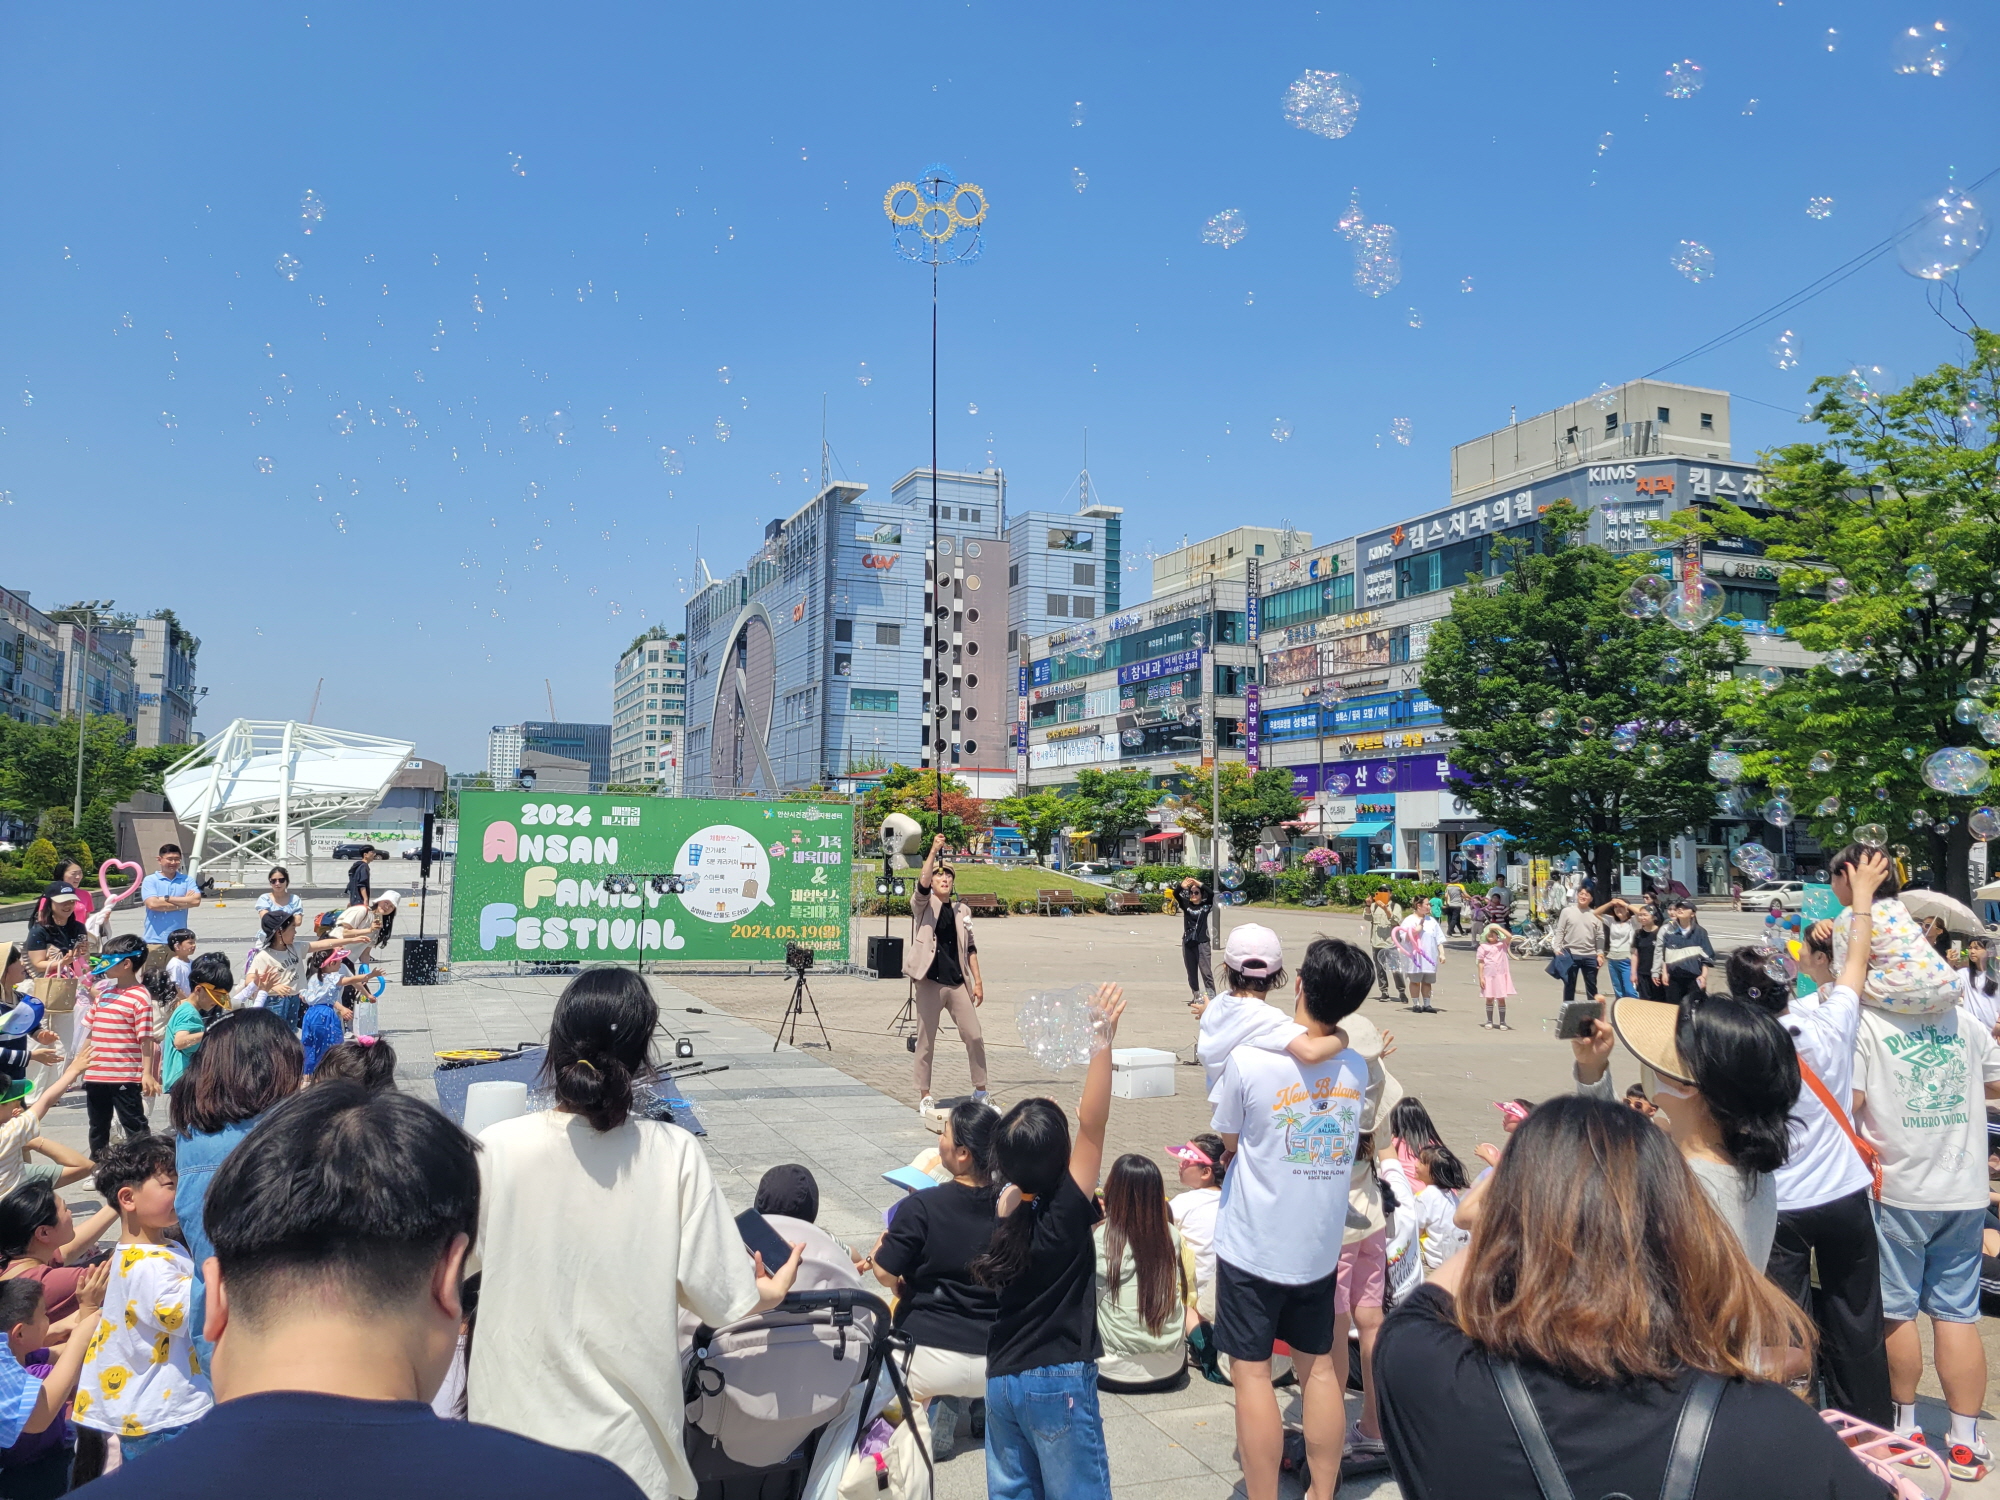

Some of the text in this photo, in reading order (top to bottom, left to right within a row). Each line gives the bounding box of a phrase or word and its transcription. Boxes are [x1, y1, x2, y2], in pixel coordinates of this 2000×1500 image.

[1589, 464, 1636, 482] KIMS
[1636, 475, 1675, 495] 치과
[1688, 467, 1775, 503] 킴스치
[1408, 490, 1533, 550] 킴스치과의원
[1606, 510, 1661, 525] 임플란트
[1368, 543, 1393, 562] KIMS
[862, 554, 897, 570] CGV
[1309, 555, 1339, 579] CMS
[1131, 650, 1198, 680] 참내과 이비인후과
[1172, 662, 1198, 673] 487-8383
[1248, 702, 1257, 757] 산부인과
[1293, 715, 1308, 728] 성형
[1355, 765, 1368, 787] 산
[521, 803, 592, 827] 2024
[602, 816, 641, 827] 페스티벌
[777, 810, 843, 820] 안산시건강지원센터
[482, 820, 618, 865] ANSAN
[817, 835, 842, 849] 가족
[792, 850, 841, 865] 체육대회
[810, 866, 828, 884] &
[790, 888, 840, 903] 체험부스
[789, 905, 840, 919] 플리마켓
[479, 902, 686, 951] FESTIVAL
[1882, 1030, 1925, 1056] Play
[1928, 1028, 1967, 1049] Peace
[1272, 1077, 1362, 1111] New Balance
[1901, 1112, 1969, 1128] UMBRO WORL
